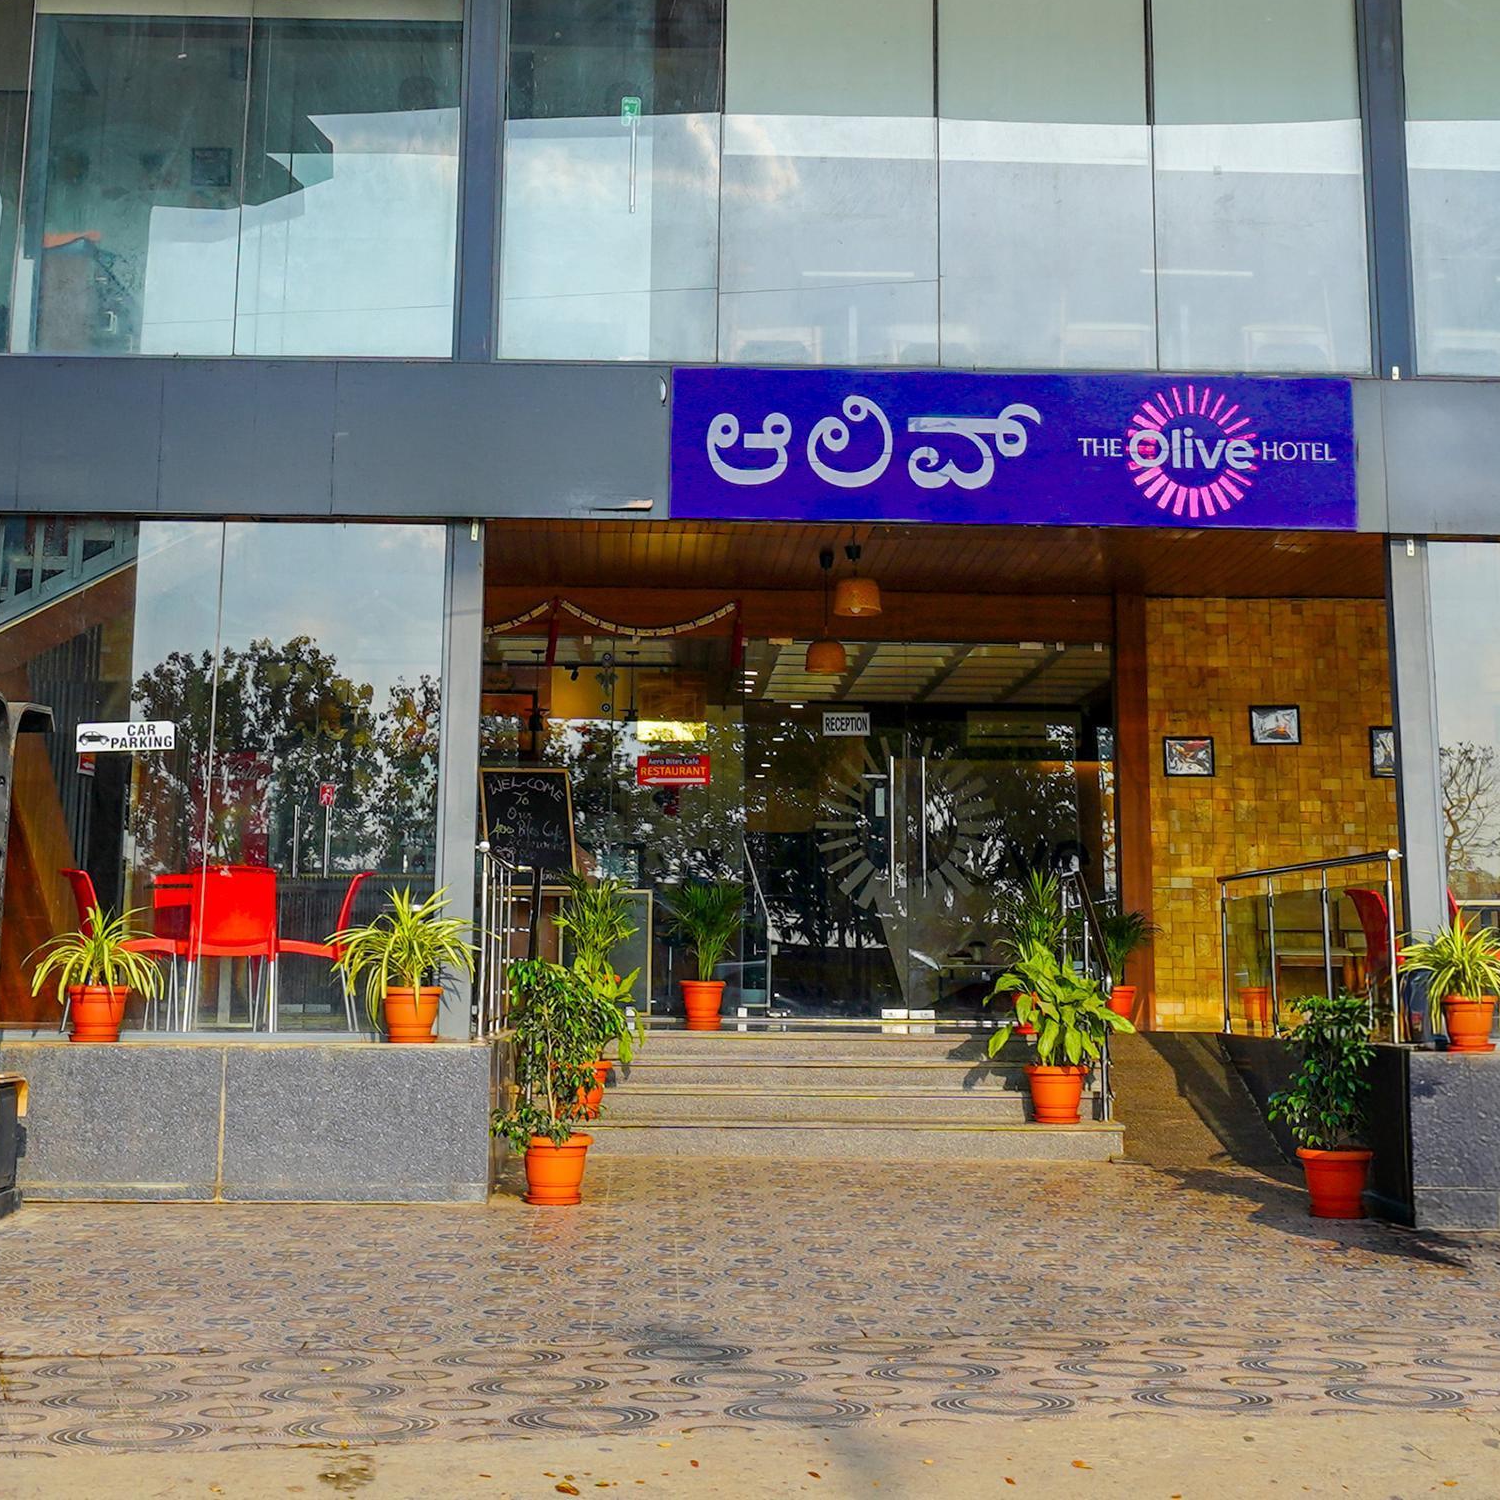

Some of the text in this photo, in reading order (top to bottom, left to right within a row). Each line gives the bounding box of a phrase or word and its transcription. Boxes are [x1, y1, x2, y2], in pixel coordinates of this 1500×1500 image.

[706, 395, 1041, 490] ಆಲಿವ್
[1077, 426, 1336, 471] THE Olive HOTEL
[127, 724, 156, 737] CAR
[825, 716, 868, 732] RECEPTION
[111, 735, 173, 749] PARKING
[640, 766, 707, 776] RESTAURANT
